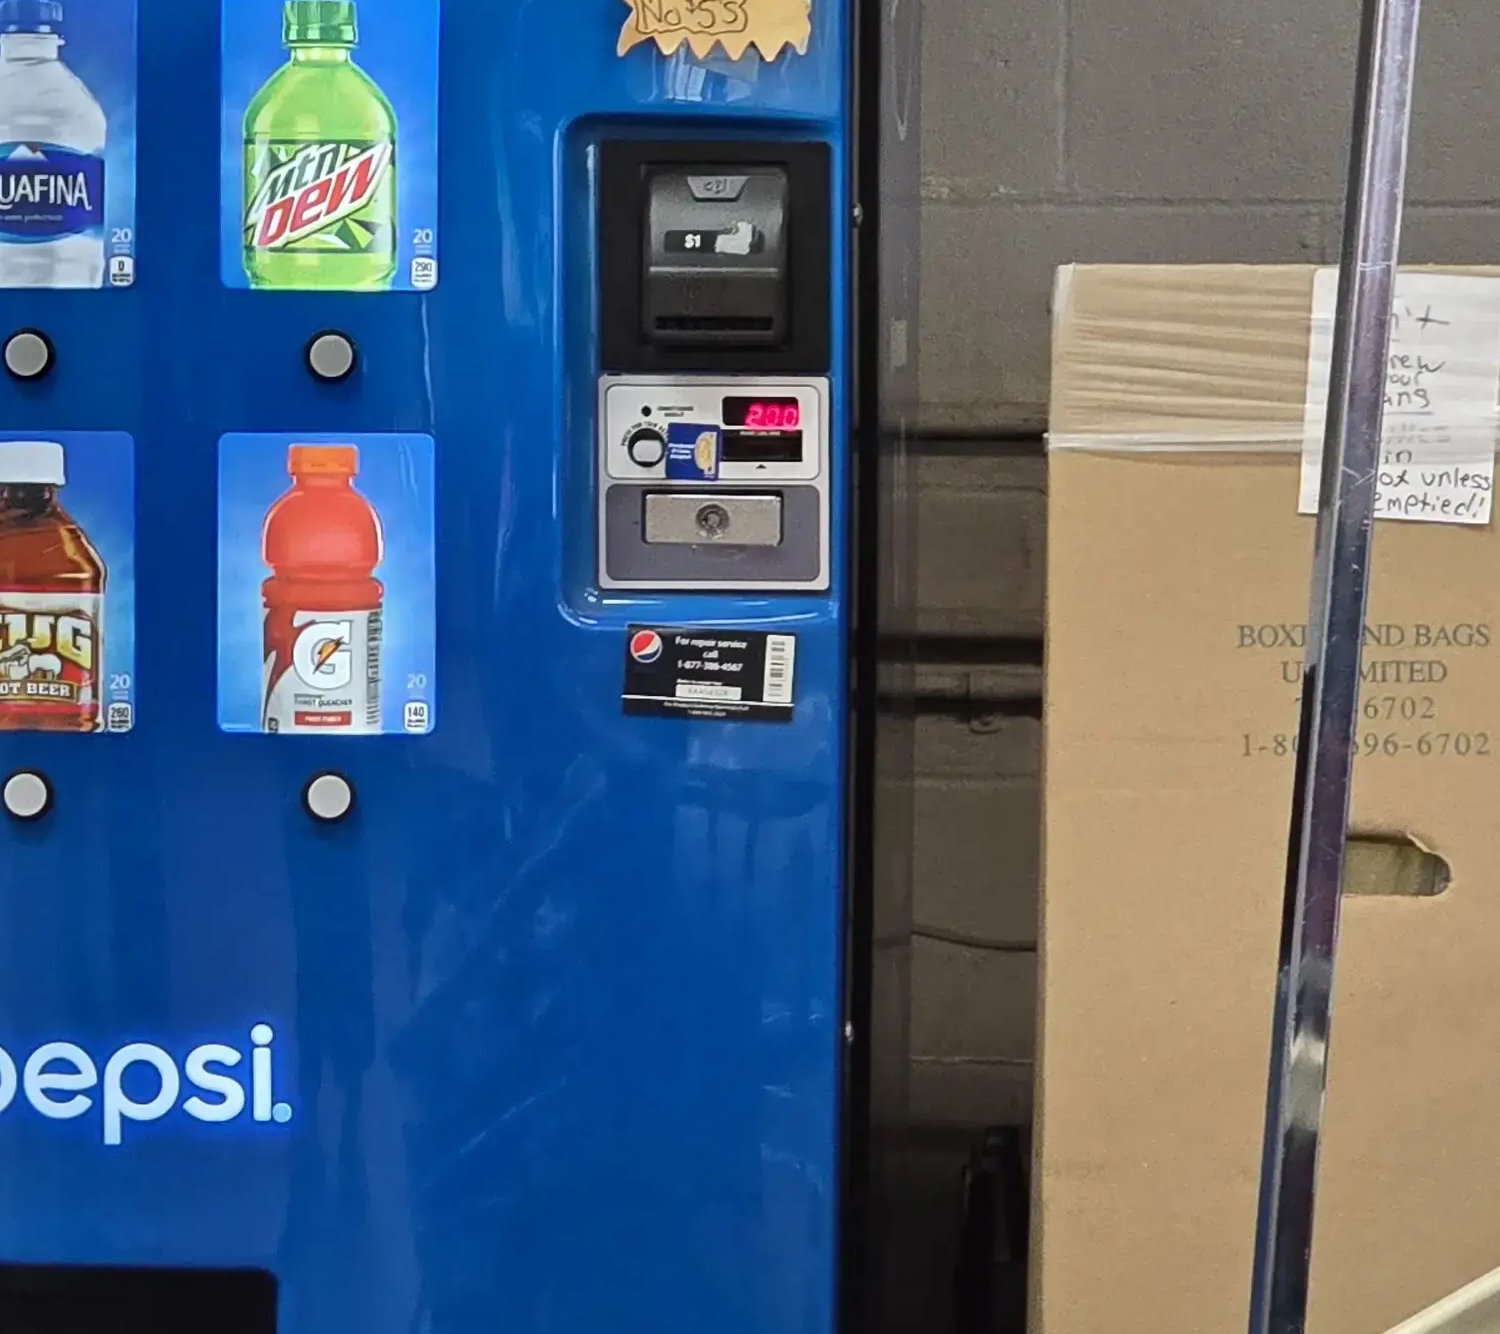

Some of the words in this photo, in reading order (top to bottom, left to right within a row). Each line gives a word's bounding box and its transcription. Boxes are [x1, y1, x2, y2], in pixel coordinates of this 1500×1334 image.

[111, 228, 132, 243] 20
[413, 228, 433, 244] 20
[1389, 371, 1423, 386] our
[1379, 469, 1409, 487] ox
[1421, 467, 1490, 491] unless
[1237, 625, 1306, 648] BOX
[1361, 625, 1405, 647] ND
[1414, 624, 1491, 647] BAGS
[292, 620, 352, 690] G
[1281, 660, 1448, 683] UMITED
[110, 674, 130, 689] 20
[407, 674, 426, 689] 20
[27, 682, 71, 697] BEER
[408, 706, 424, 718] 140
